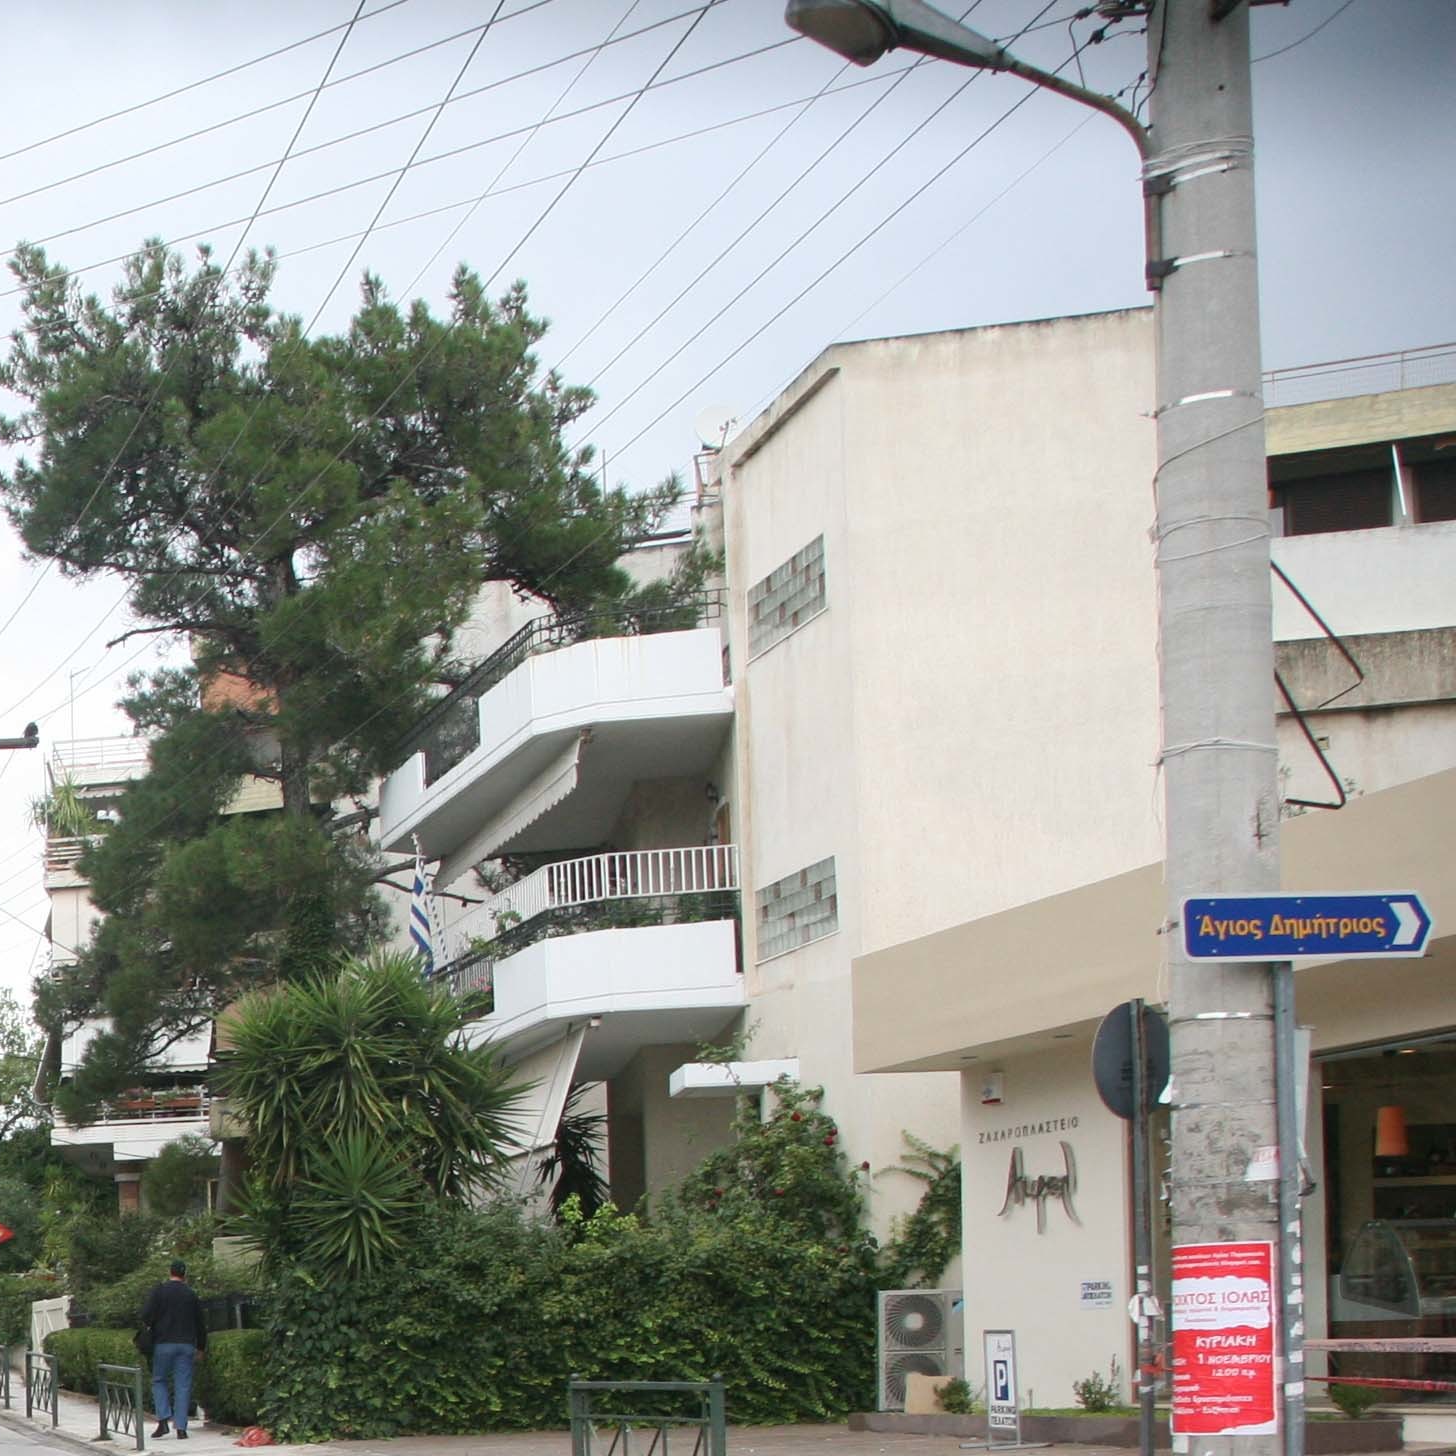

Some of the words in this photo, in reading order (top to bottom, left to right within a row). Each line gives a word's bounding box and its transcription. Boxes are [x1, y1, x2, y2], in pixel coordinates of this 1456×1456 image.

[1196, 913, 1264, 941] Άγιος
[1269, 912, 1387, 940] Δημήτριος
[978, 1116, 1080, 1145] ΖΑΧΑΡΟΠΛΑΣΤΕΙΟ
[1195, 1335, 1256, 1348] ΚΥΡΙΑΚΗ
